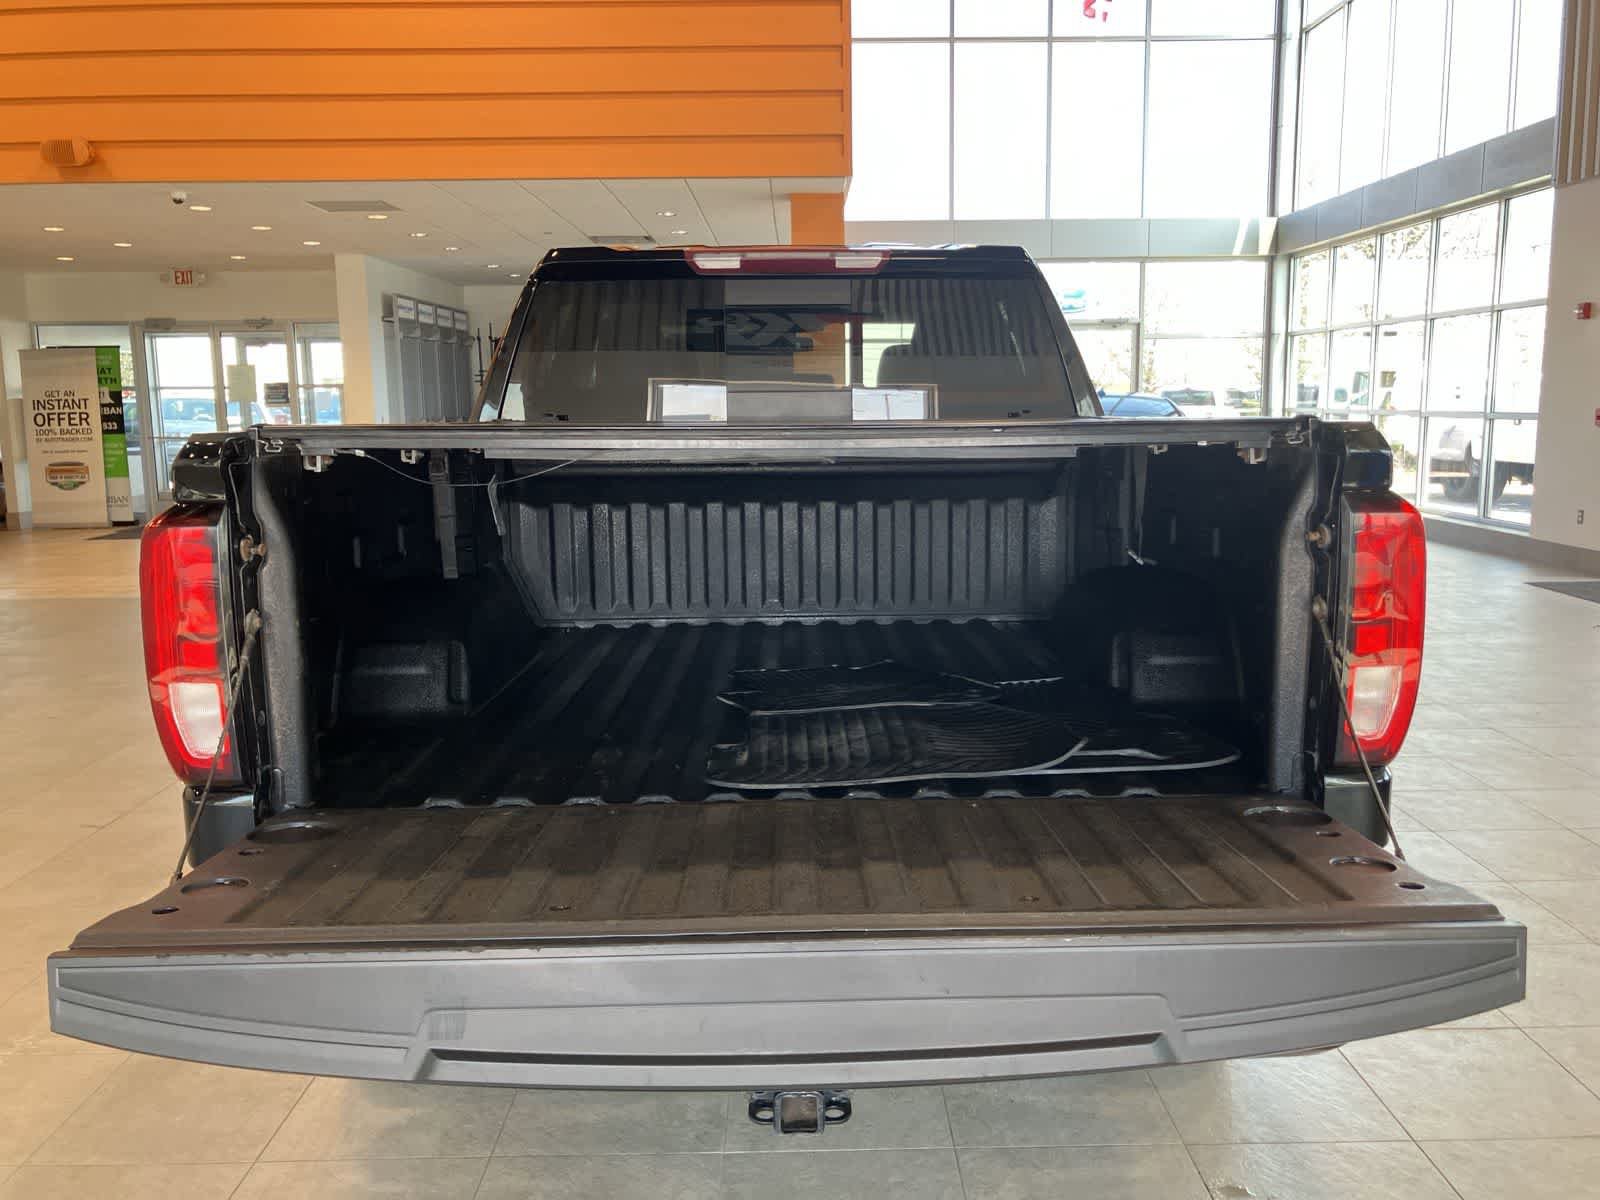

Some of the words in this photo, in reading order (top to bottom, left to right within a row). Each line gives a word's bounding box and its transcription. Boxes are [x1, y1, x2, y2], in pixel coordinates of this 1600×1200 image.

[174, 269, 193, 285] EXIT
[44, 390, 60, 398] GET
[63, 390, 75, 398] AN
[32, 398, 90, 411] INSTANT
[33, 412, 90, 427] OFFER
[35, 428, 57, 436] 100%
[59, 427, 93, 436] BACKED
